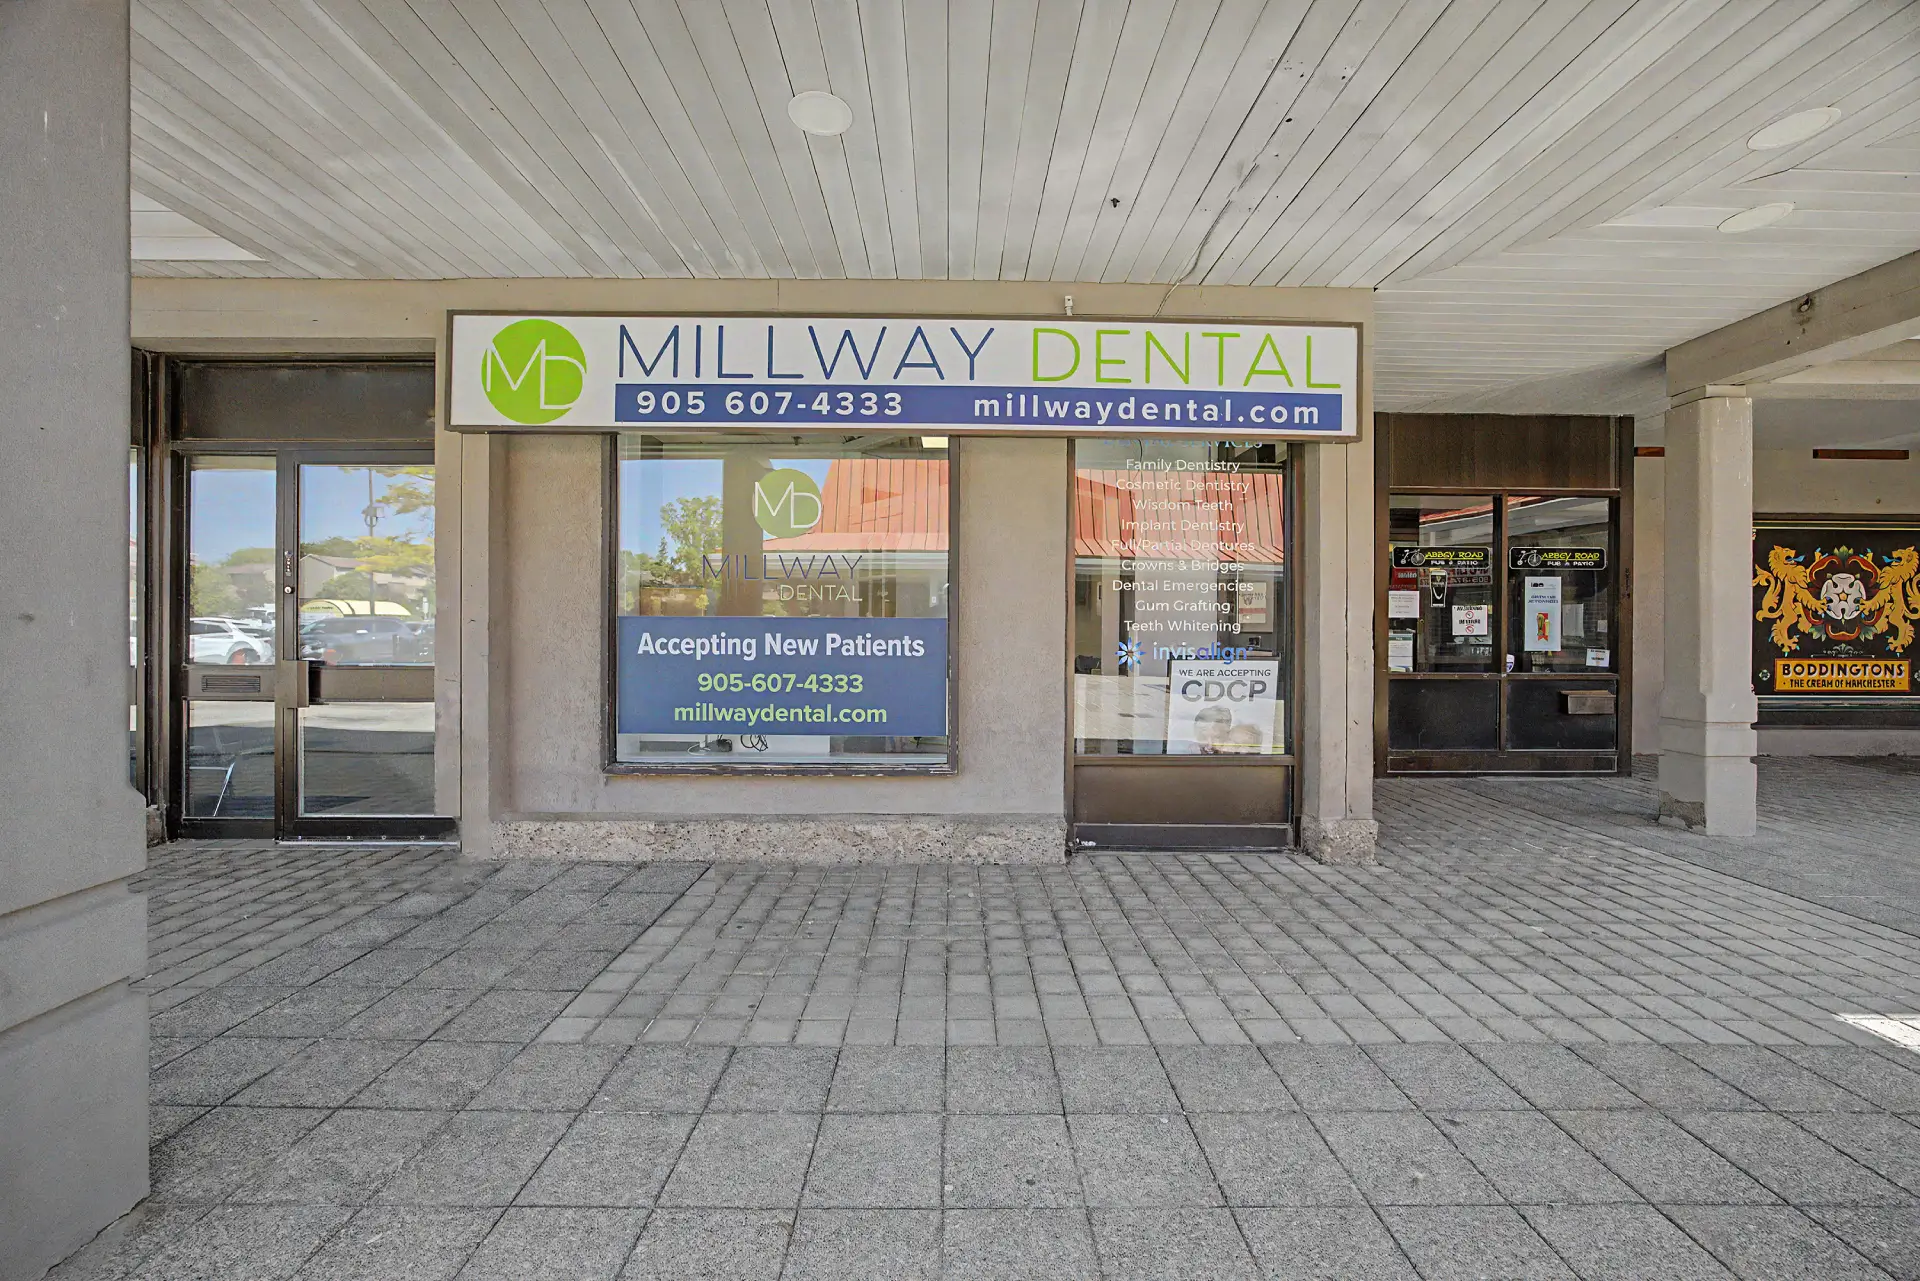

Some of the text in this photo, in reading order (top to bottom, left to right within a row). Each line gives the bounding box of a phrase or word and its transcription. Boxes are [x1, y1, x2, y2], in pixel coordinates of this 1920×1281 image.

[619, 324, 1341, 389] MILLWAY DENTAL
[637, 391, 1320, 425] 905 607-4333 millwaydental.com
[1126, 459, 1241, 474] Family Dentistry
[1116, 479, 1250, 494] Cosmetic Dentistry
[754, 481, 821, 529] MD
[1133, 499, 1233, 511] Wisdom Teeth
[1121, 519, 1245, 535] Implant Dentistry
[1111, 540, 1255, 552] Full/Partial Dentures
[702, 554, 863, 580] MILLWAY
[1121, 560, 1245, 574] Crowns & Bridges
[780, 584, 863, 602] DENTAL
[1112, 580, 1254, 593] Dental Emergencies
[1135, 600, 1231, 614] Gum Grafting
[1124, 620, 1241, 634] Teeth Whitening
[637, 632, 925, 660] Accepting New Patients
[1153, 641, 1248, 665] invisalign
[1217, 669, 1271, 677] ACCEPTING
[1782, 663, 1905, 678] BODDINGTONS
[697, 673, 864, 693] 905-607-4333
[1790, 679, 1804, 688] THE
[1806, 679, 1832, 688] CREAM
[1181, 680, 1267, 702] CDCP
[674, 702, 887, 726] millwaydental.com
